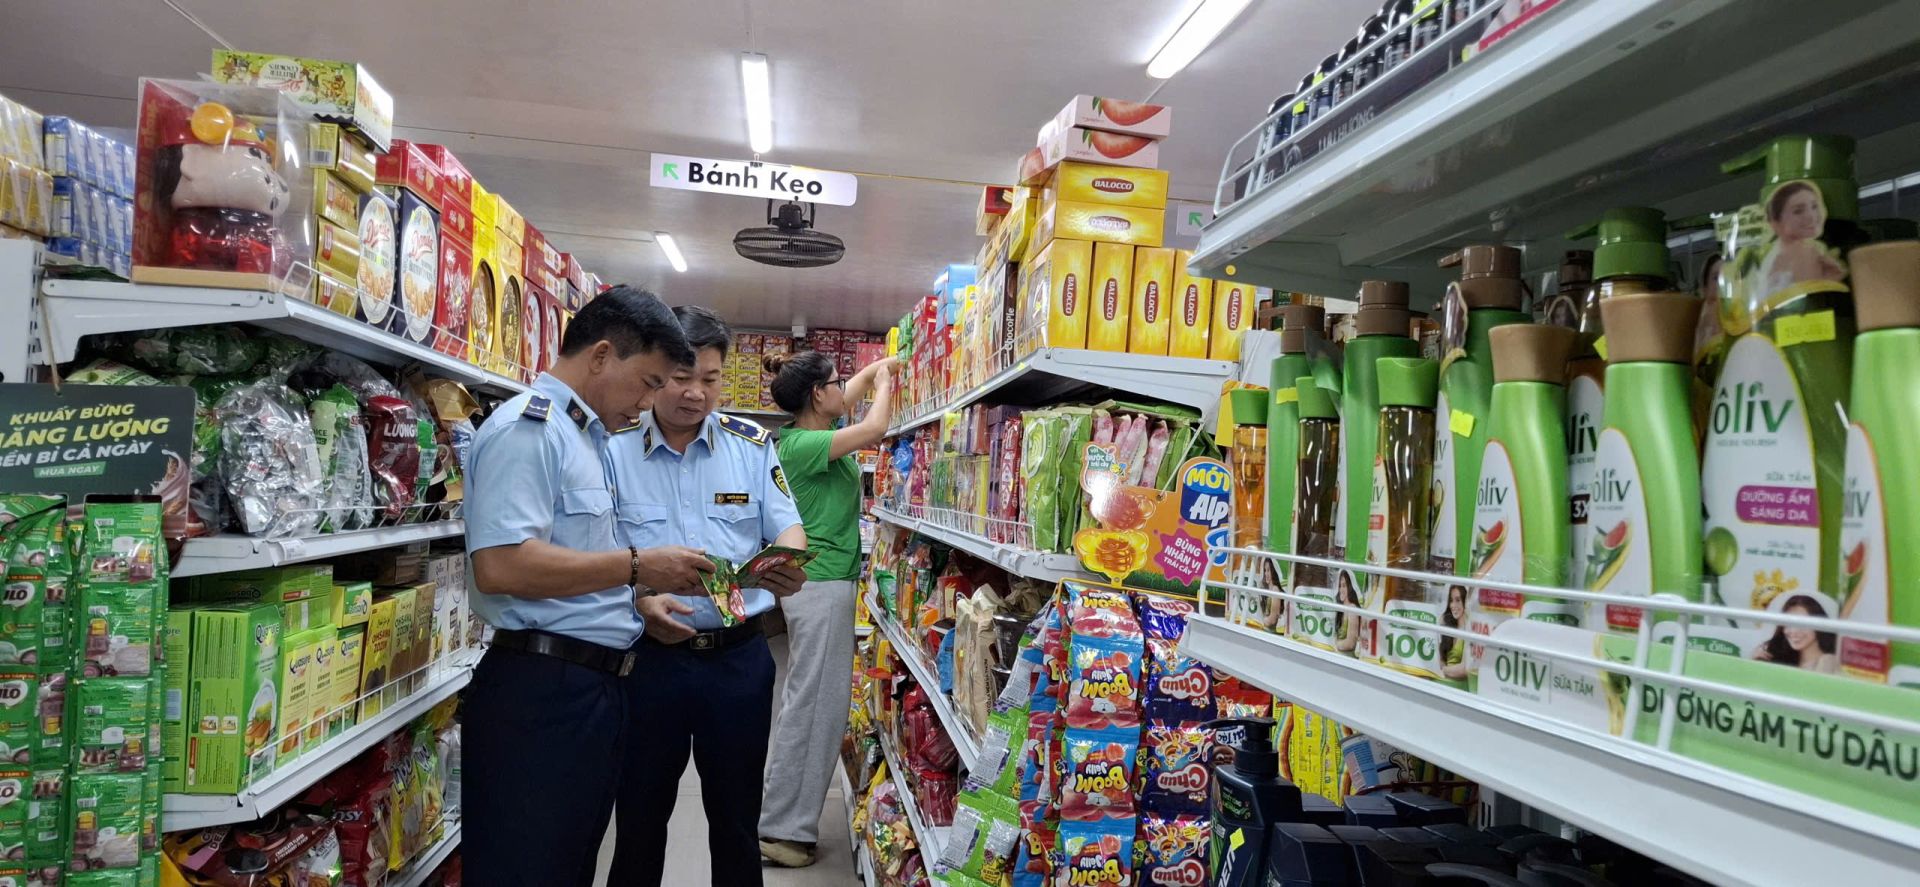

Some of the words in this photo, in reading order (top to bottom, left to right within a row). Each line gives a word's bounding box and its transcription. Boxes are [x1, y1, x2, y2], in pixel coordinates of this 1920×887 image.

[688, 162, 758, 189] Bánh
[770, 170, 823, 201] Kẹo
[1094, 181, 1132, 190] BALOCCO
[1065, 276, 1074, 314] BALOCCO
[1106, 280, 1116, 319] BALOCCO
[1146, 283, 1156, 322] BALOCCO
[1187, 287, 1196, 325] BALOCCO
[1229, 291, 1239, 329] BALOCCO
[9, 404, 78, 426] KHUẤY
[79, 402, 136, 420] BỪNG
[73, 417, 171, 443] LƯỢNG
[36, 444, 61, 465] BỈ
[62, 442, 95, 462] CẢ
[95, 439, 153, 459] NGÀY
[39, 467, 65, 477] MUA
[67, 465, 101, 475] NGAY
[1741, 489, 1785, 503] DƯỠNG
[1750, 505, 1785, 519] SÁNG
[1787, 509, 1809, 521] DA
[1164, 545, 1192, 566] NHÂN
[1191, 558, 1202, 574] VỊ
[1174, 537, 1202, 557] BÙNG
[1163, 556, 1179, 569] TRÁI
[1178, 564, 1193, 576] CÂY
[3, 589, 28, 601] ILO
[1368, 619, 1378, 657] 1
[0, 688, 21, 699] ILO
[1161, 671, 1207, 696] Chun
[1553, 674, 1572, 690] SỮA
[1792, 716, 1839, 760] TỪ
[1085, 761, 1109, 775] Jelly
[1159, 765, 1207, 790] Chun
[1154, 861, 1202, 885] Chun
